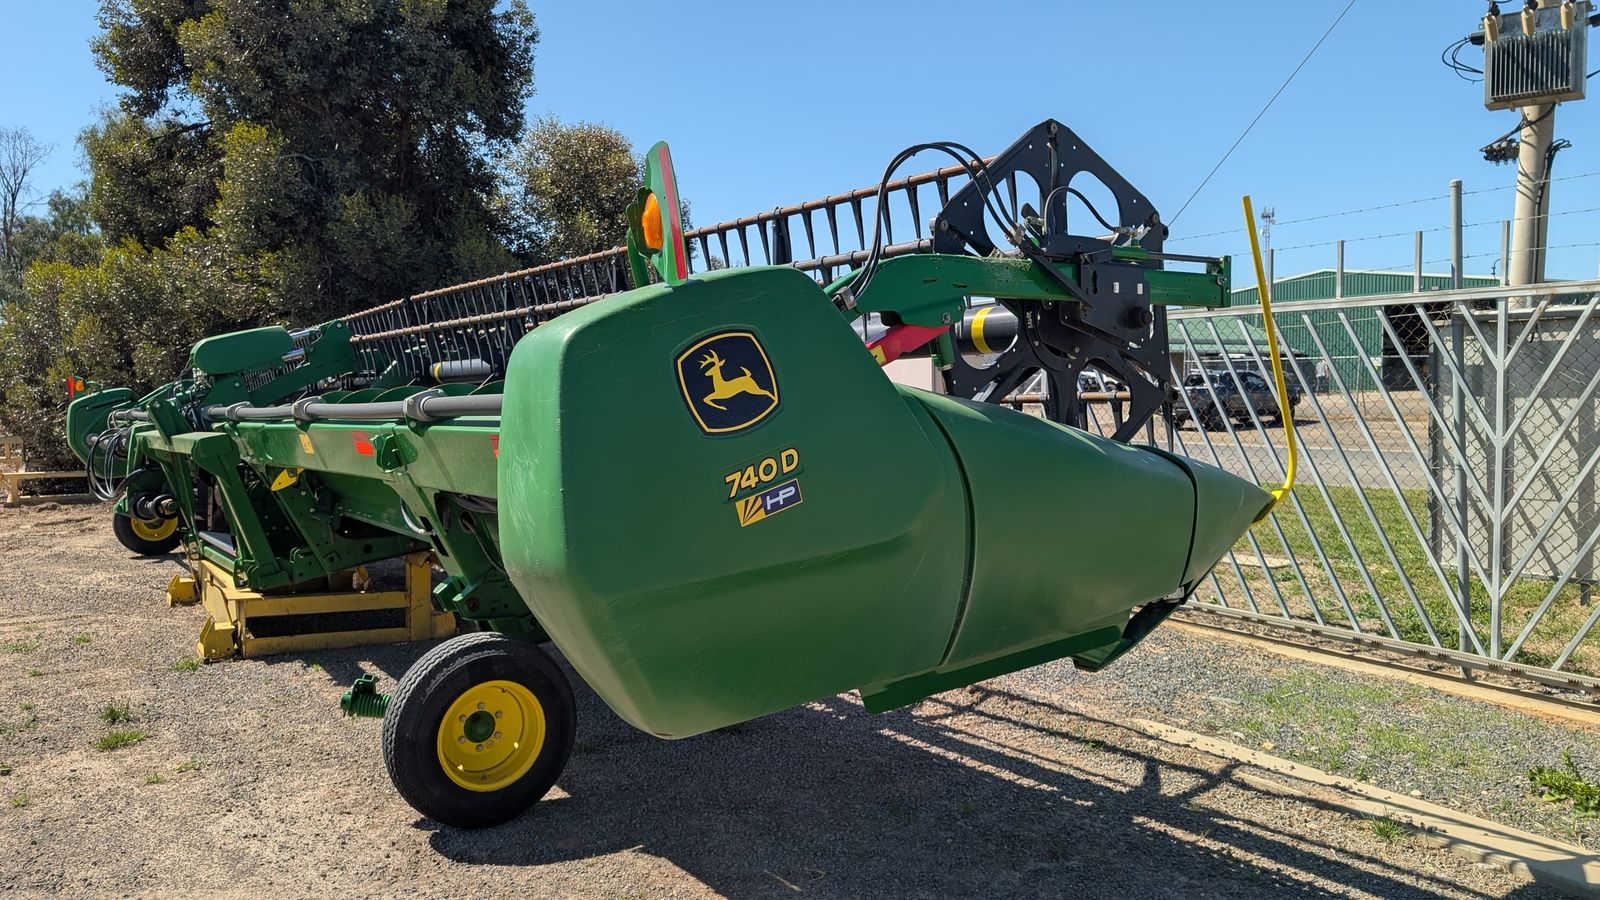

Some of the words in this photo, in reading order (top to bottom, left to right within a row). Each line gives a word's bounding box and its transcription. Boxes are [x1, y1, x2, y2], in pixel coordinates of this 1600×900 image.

[725, 457, 778, 499] 740
[780, 448, 799, 474] D
[766, 486, 796, 511] HP
